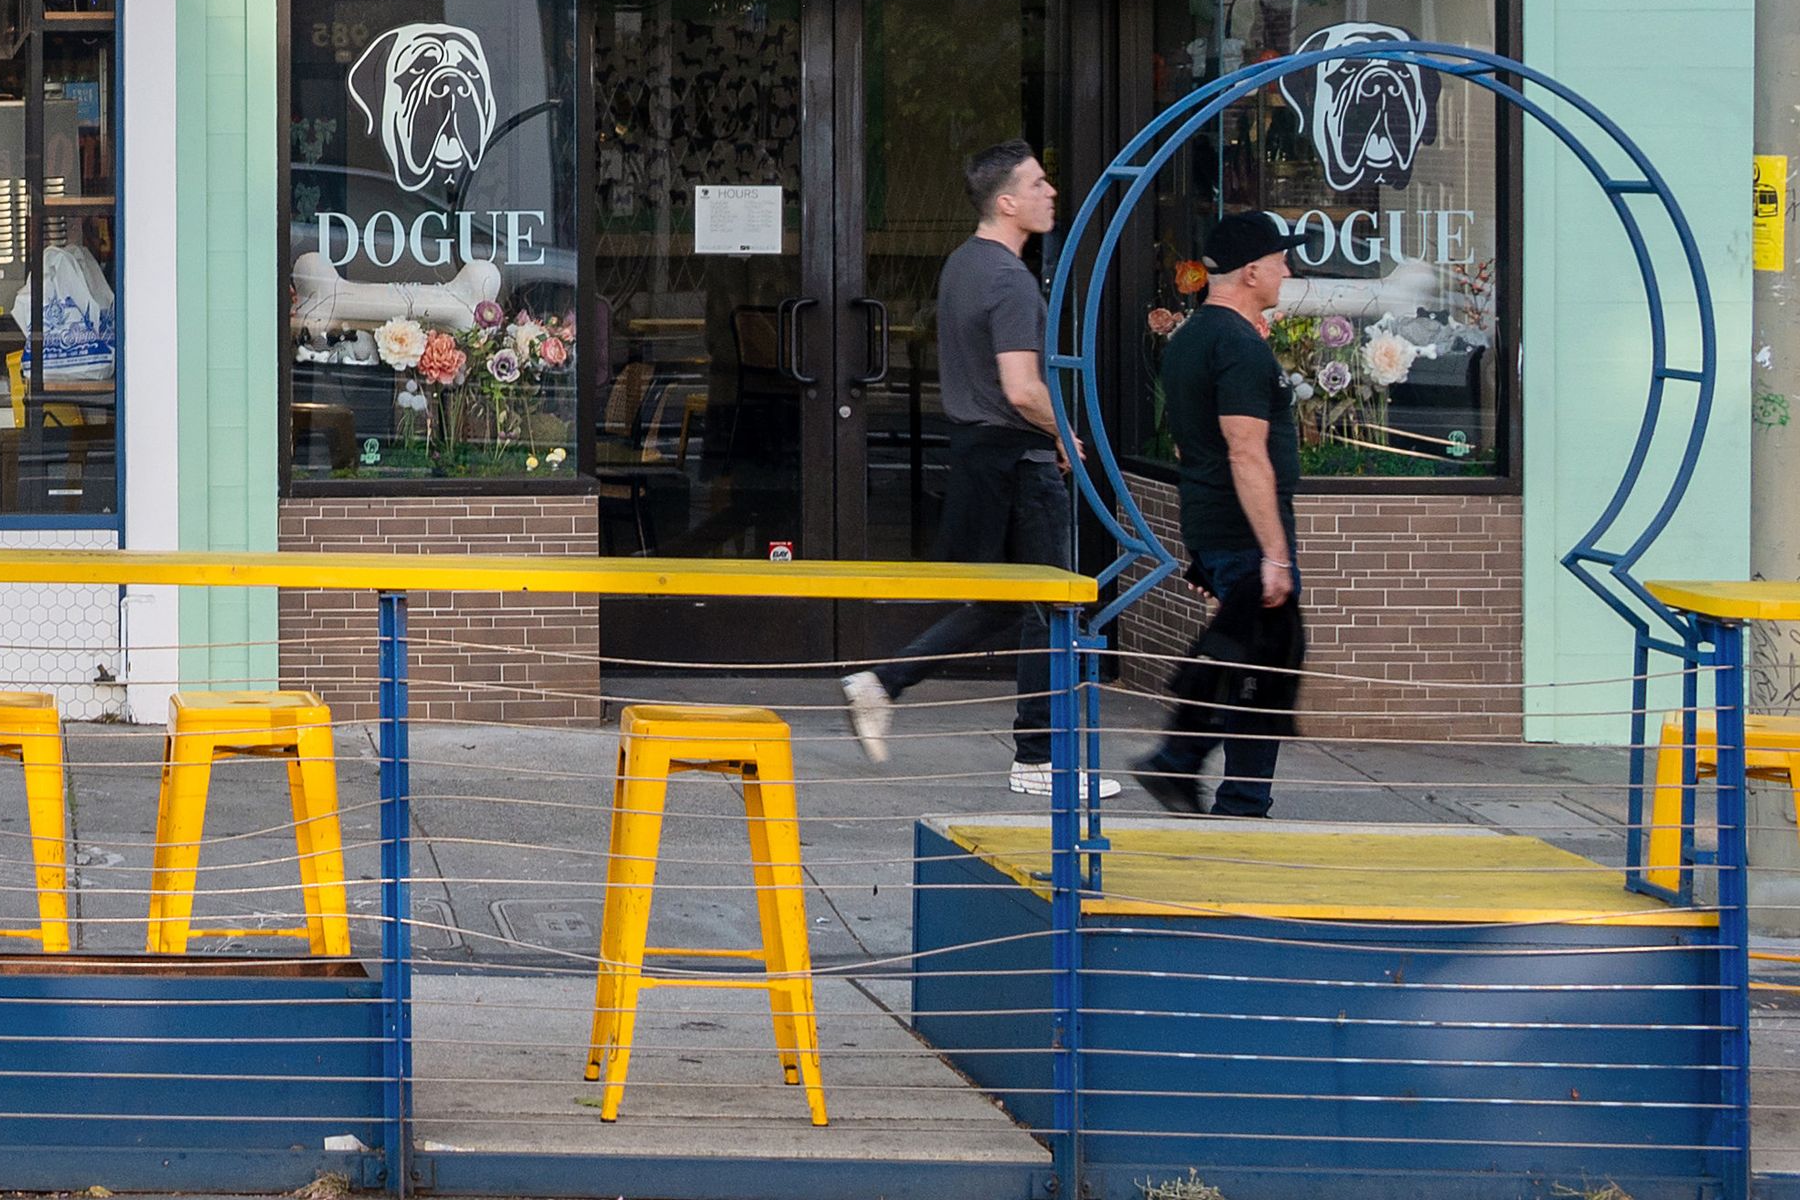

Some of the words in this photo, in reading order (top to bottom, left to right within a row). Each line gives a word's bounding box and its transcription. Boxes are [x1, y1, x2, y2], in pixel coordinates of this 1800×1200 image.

[718, 188, 759, 200] HOURS
[314, 210, 545, 267] DOGUE
[1263, 209, 1475, 266] OGUE
